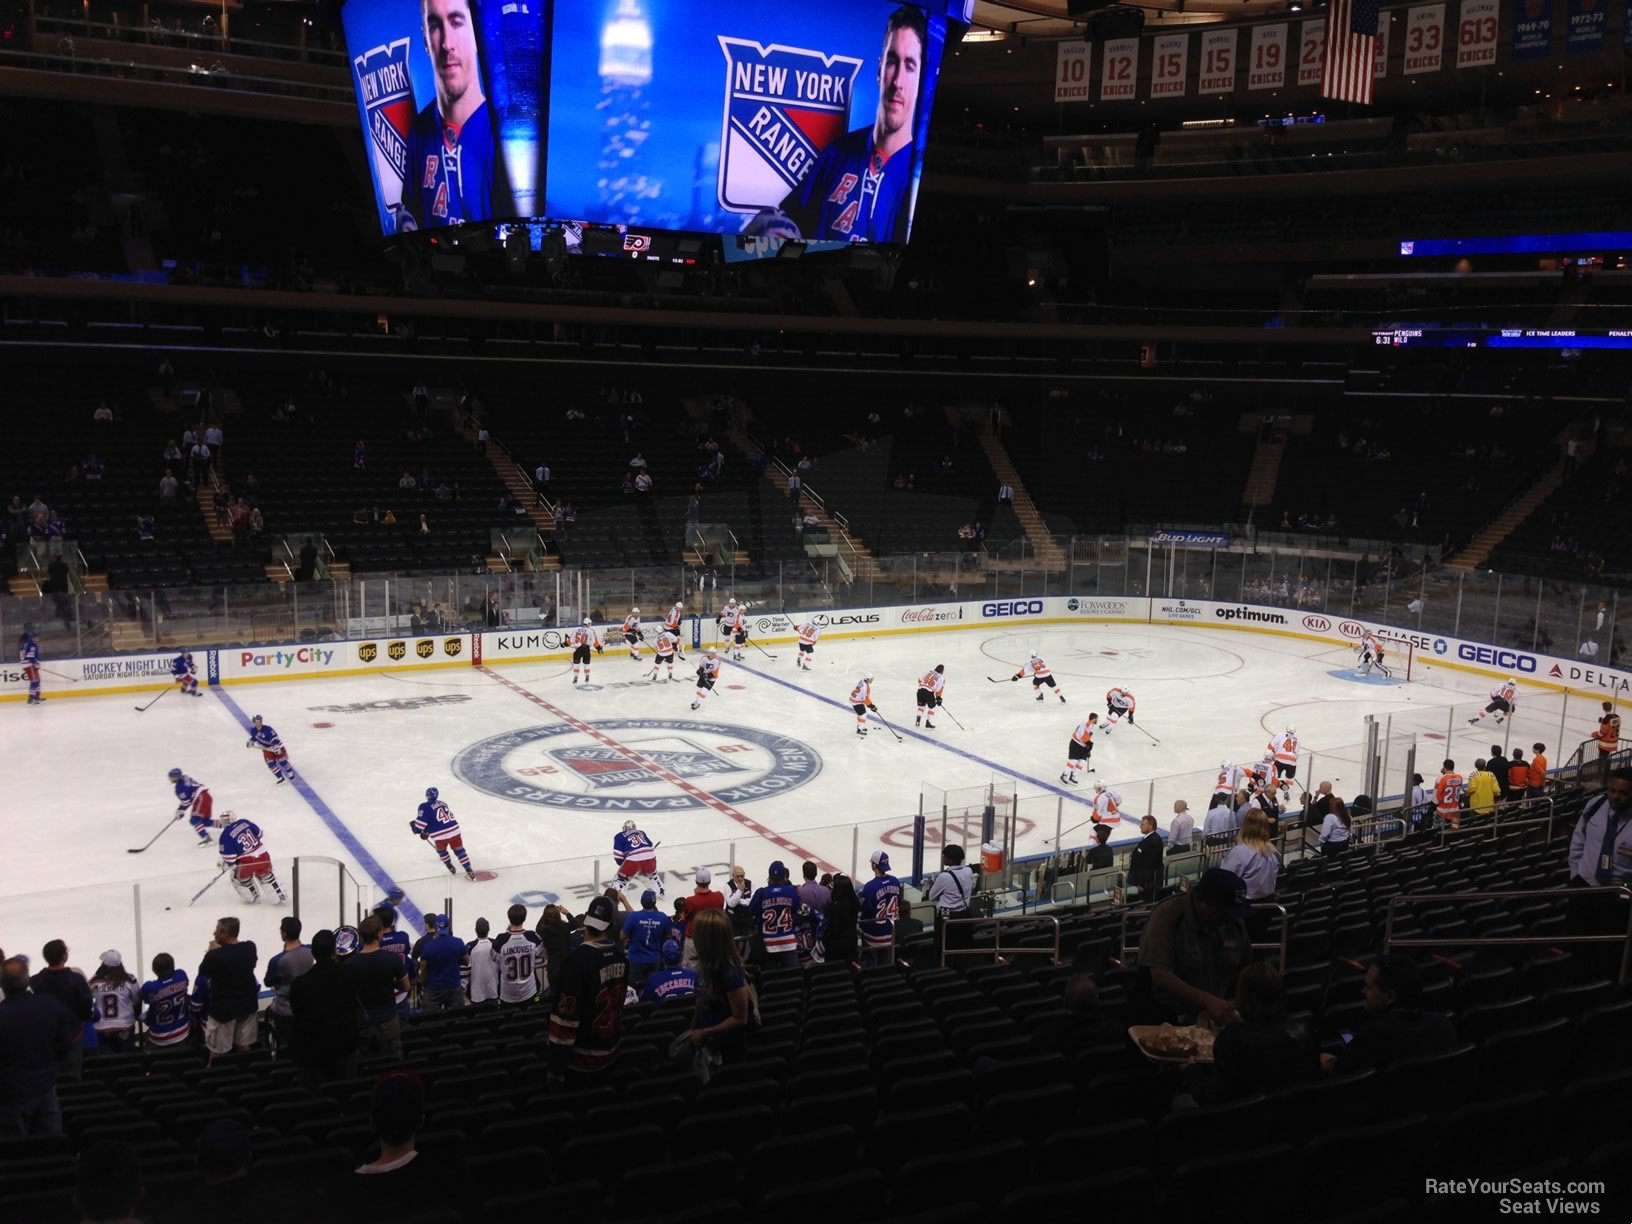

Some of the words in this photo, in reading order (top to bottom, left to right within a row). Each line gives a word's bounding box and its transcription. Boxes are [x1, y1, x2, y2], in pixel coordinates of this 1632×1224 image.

[1409, 24, 1441, 52] 33
[1461, 16, 1497, 46] 613
[1206, 48, 1231, 74] 15
[1256, 43, 1281, 69] 19
[1406, 54, 1440, 69] KNICKS
[1459, 48, 1494, 63] KNICKS
[1062, 58, 1085, 82] 10
[1108, 57, 1132, 80] 12
[1158, 53, 1182, 79] 15
[379, 61, 409, 95] YORK
[735, 61, 788, 96] NEW
[796, 70, 846, 104] YORK
[1153, 81, 1185, 94] KNICKS
[1200, 77, 1233, 89] KNICKS
[1250, 71, 1283, 85] KNICKS
[1057, 86, 1088, 97] KNICKS
[1103, 84, 1134, 97] KNICKS
[1157, 532, 1186, 542] BUD
[1186, 534, 1225, 545] LIGHT
[982, 600, 1044, 618] GEICO
[831, 614, 880, 625] LEXUS
[1307, 619, 1327, 630] KIA
[360, 648, 376, 660] ups
[389, 646, 405, 658] ups
[417, 644, 433, 656] ups
[444, 641, 461, 654] ups
[83, 661, 123, 675] HOCKEY
[125, 659, 156, 672] NIGHT
[1458, 643, 1537, 673] GEICO
[83, 672, 115, 681] SATURDAY
[117, 670, 140, 680] NIGHTS
[142, 669, 151, 678] ON
[1570, 667, 1630, 691] DELTA
[777, 747, 809, 771] NEW
[589, 769, 657, 784] YORK
[504, 786, 693, 809] RANGERS
[716, 774, 798, 801] YORK
[237, 828, 259, 852] 31
[876, 894, 901, 921] 24
[761, 907, 794, 935] 24
[502, 944, 533, 956] LUNDQVIST
[504, 954, 533, 982] 30
[103, 993, 119, 1019] 8
